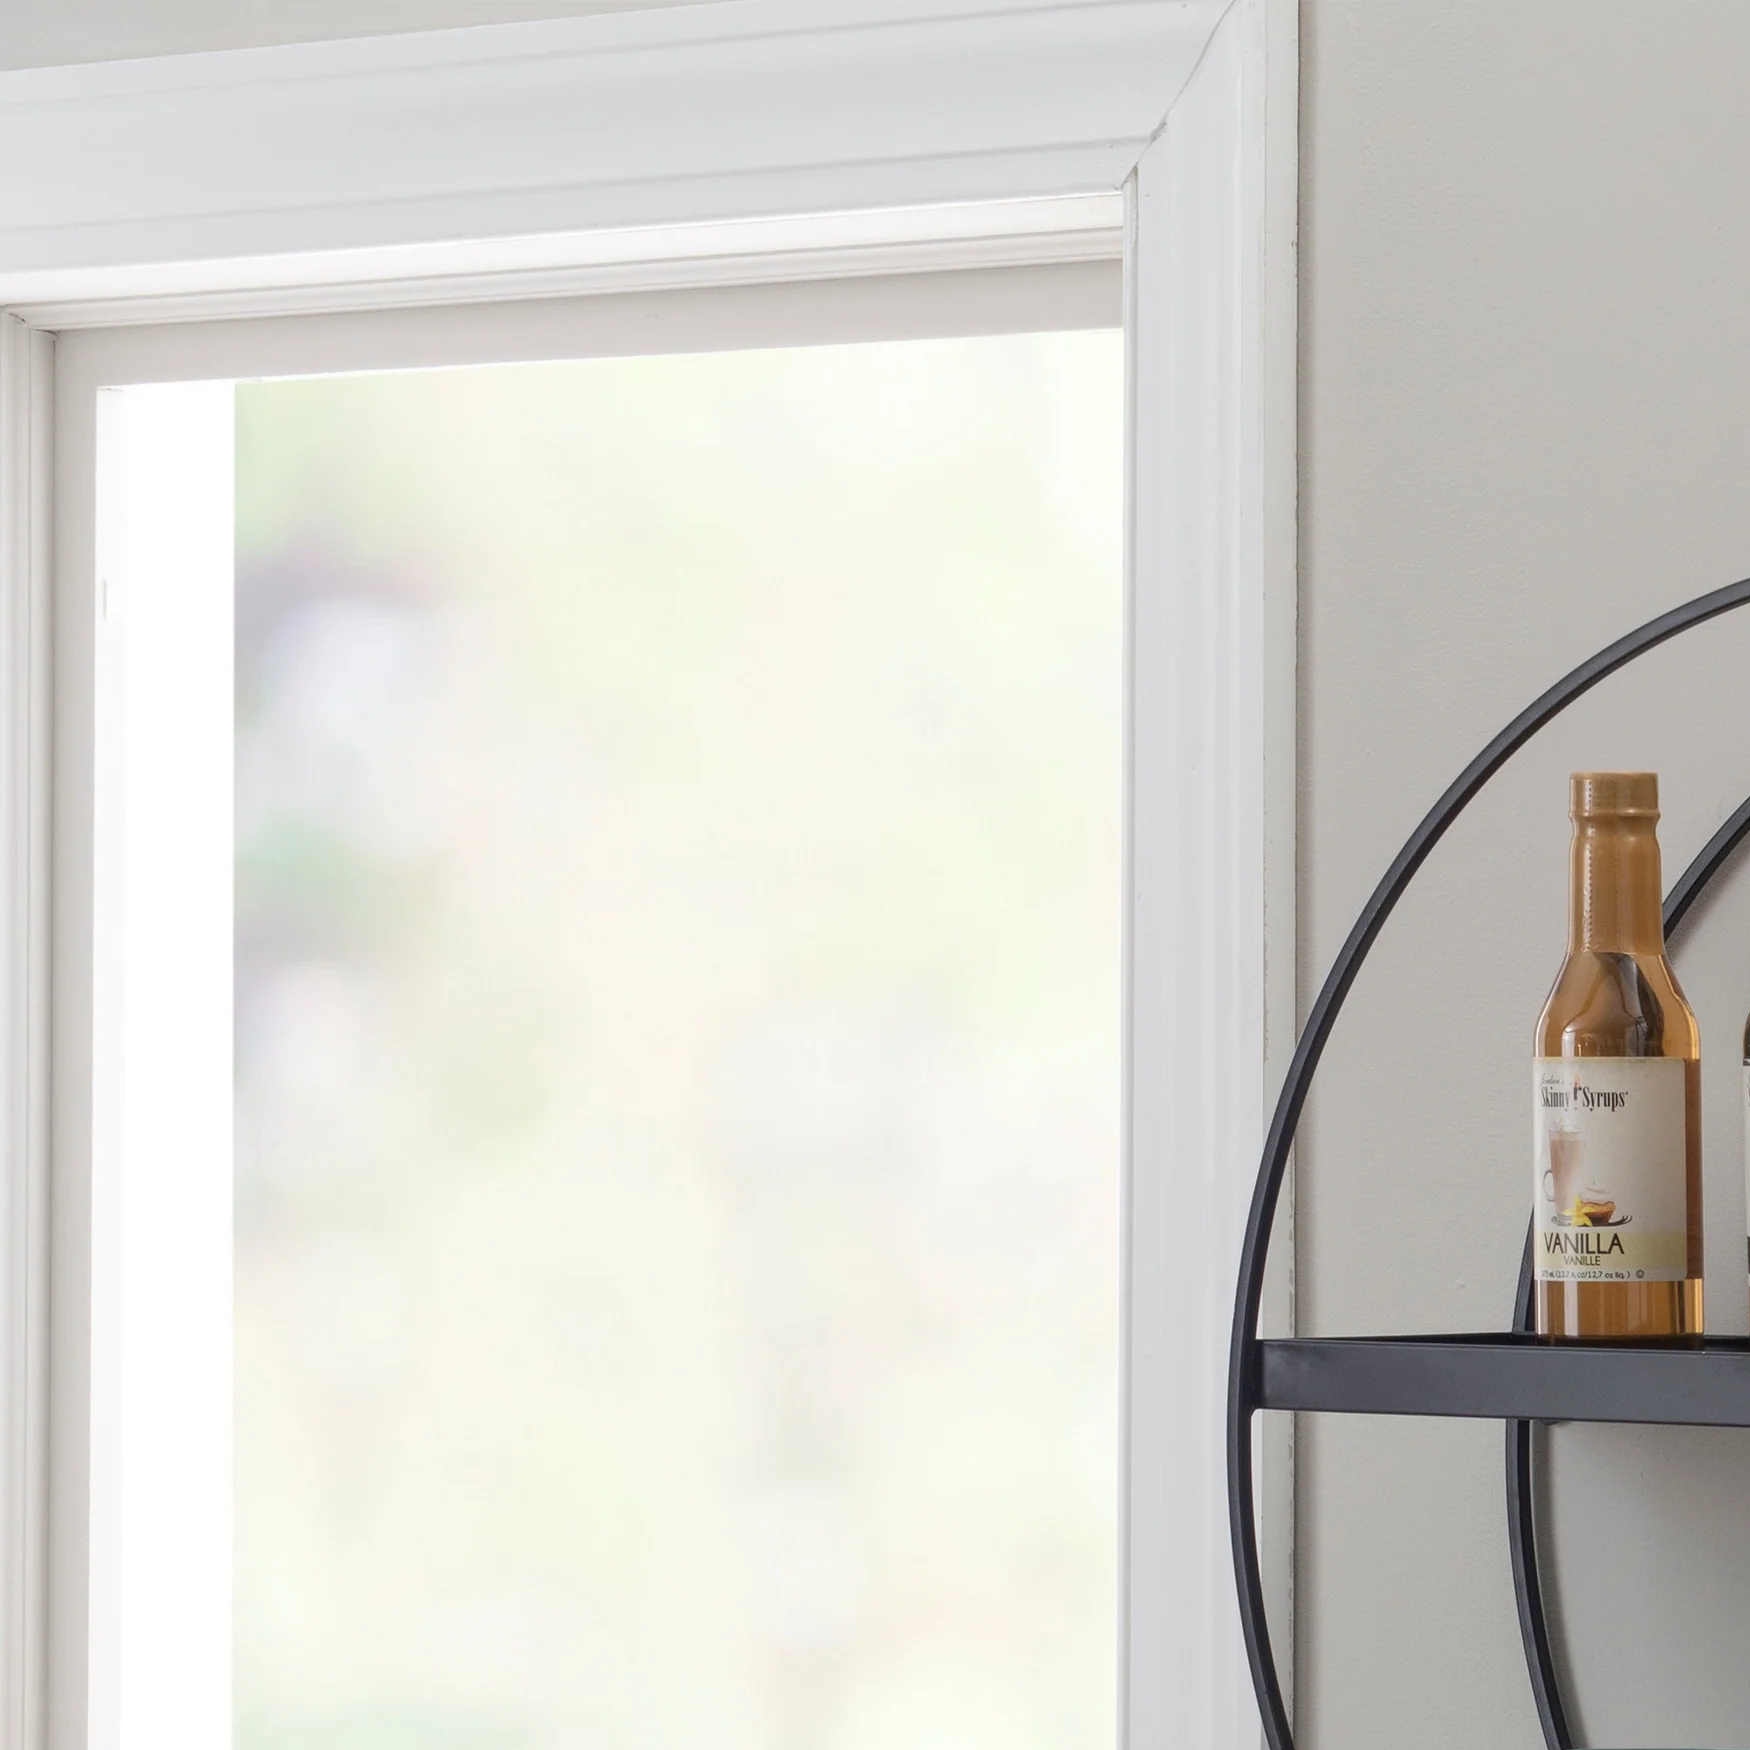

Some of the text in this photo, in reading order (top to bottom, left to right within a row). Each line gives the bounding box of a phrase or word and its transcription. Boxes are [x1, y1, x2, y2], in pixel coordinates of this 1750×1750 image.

[1541, 1086, 1626, 1112] Skinny Syrups
[1544, 1232, 1625, 1254] VANILLA
[1563, 1255, 1601, 1266] VANILLE
